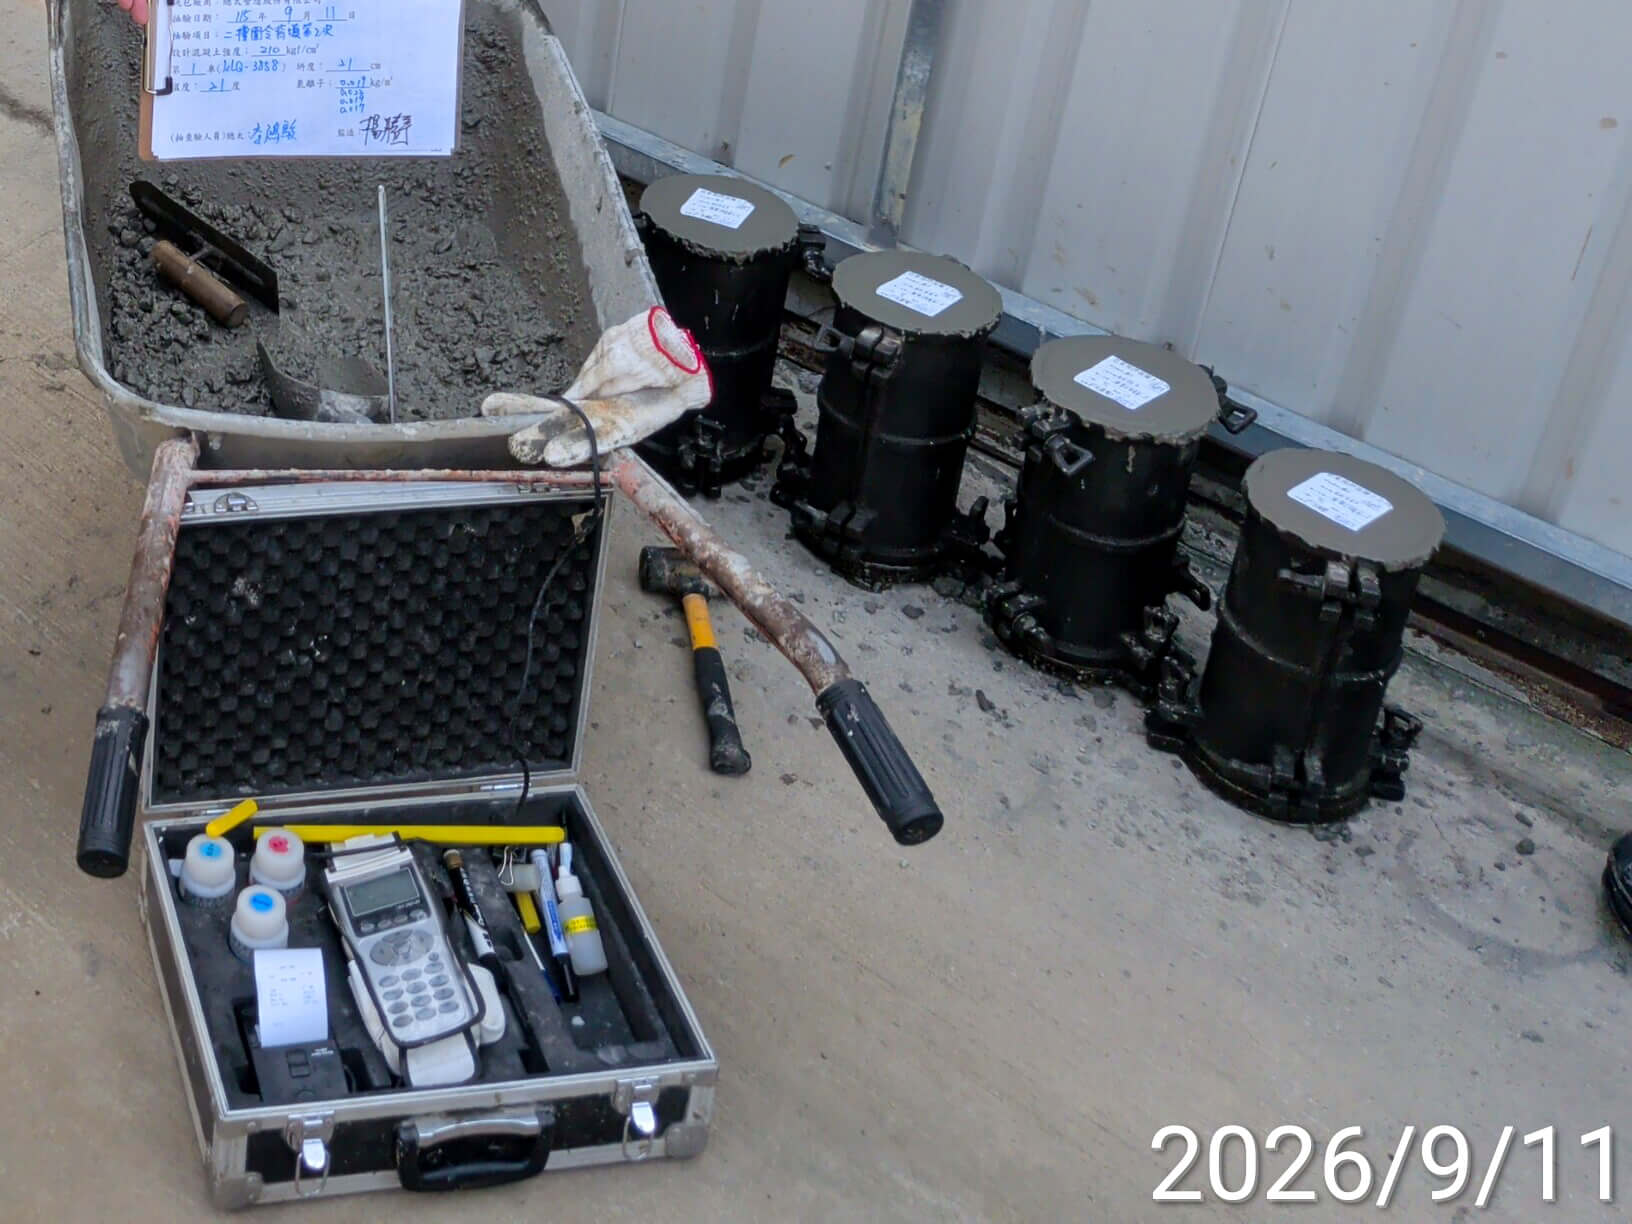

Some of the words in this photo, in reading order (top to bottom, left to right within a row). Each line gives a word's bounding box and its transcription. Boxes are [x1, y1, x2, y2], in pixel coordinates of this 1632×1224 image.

[235, 9, 252, 23] 115
[283, 5, 293, 24] 9
[324, 5, 336, 20] 11
[259, 45, 280, 55] 210
[369, 61, 382, 70] cm
